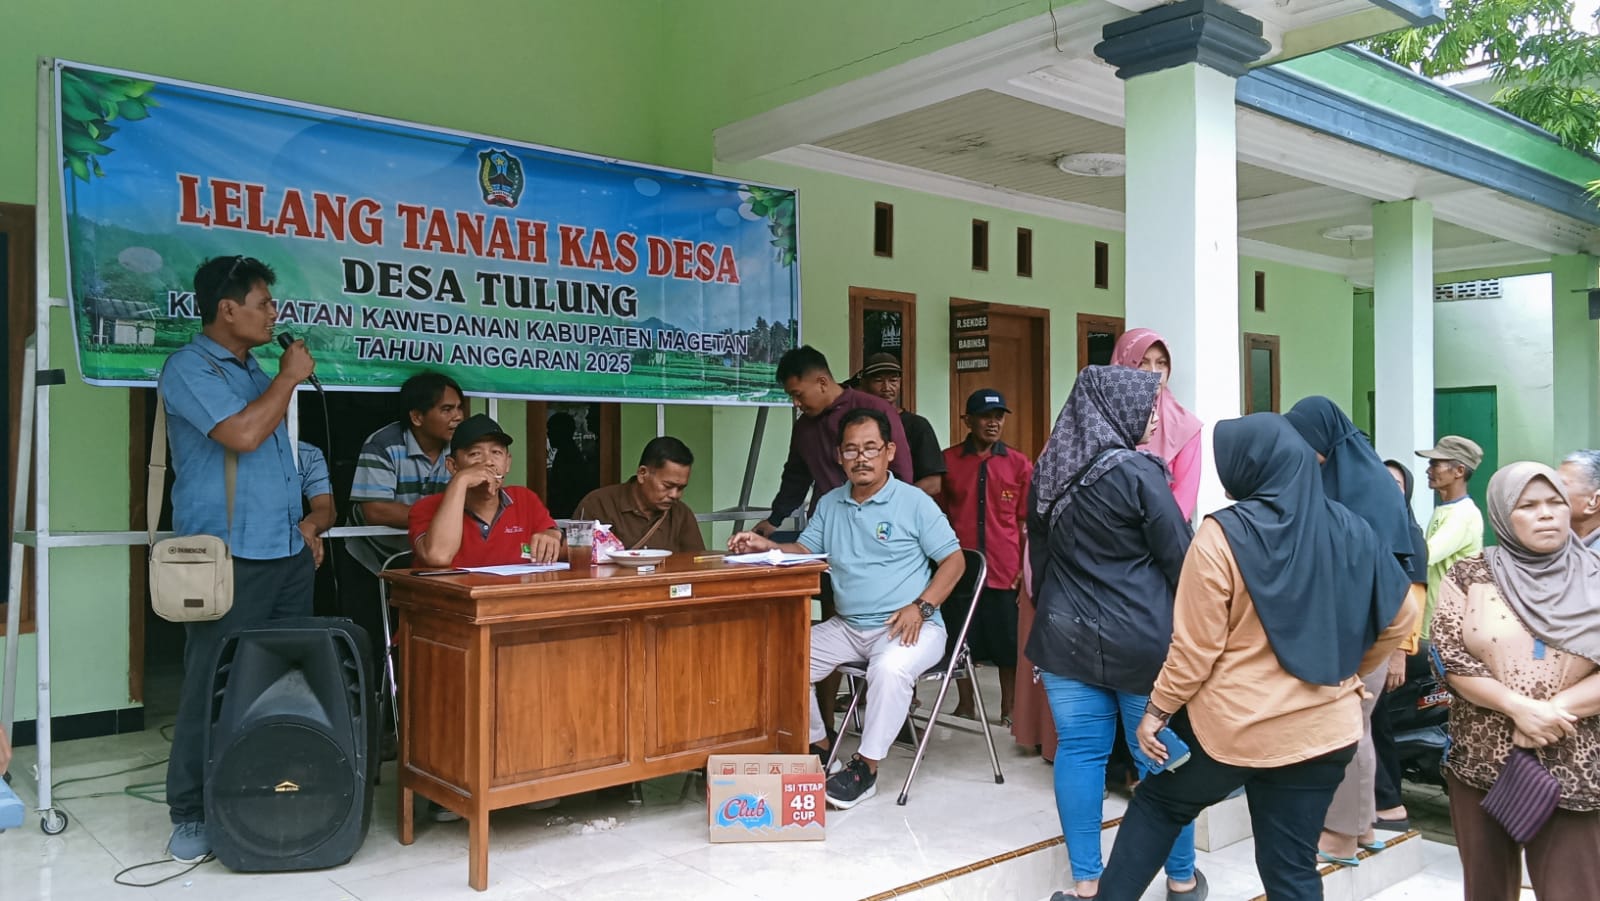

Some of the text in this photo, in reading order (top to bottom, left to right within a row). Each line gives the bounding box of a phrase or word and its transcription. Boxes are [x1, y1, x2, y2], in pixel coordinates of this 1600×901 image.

[178, 174, 740, 284] LELANG TANAH KAS DESA
[342, 258, 638, 318] DESA TULUNG
[168, 290, 748, 354] KATAN KAWEDANAN KABUPATEN MAGETAN
[958, 338, 986, 349] BABINSA
[355, 337, 632, 374] TAHUN ANGGARAN 2025
[784, 782, 824, 793] ISI TETAP
[723, 798, 765, 820] Club
[790, 794, 816, 811] 48
[793, 811, 816, 821] CUP
